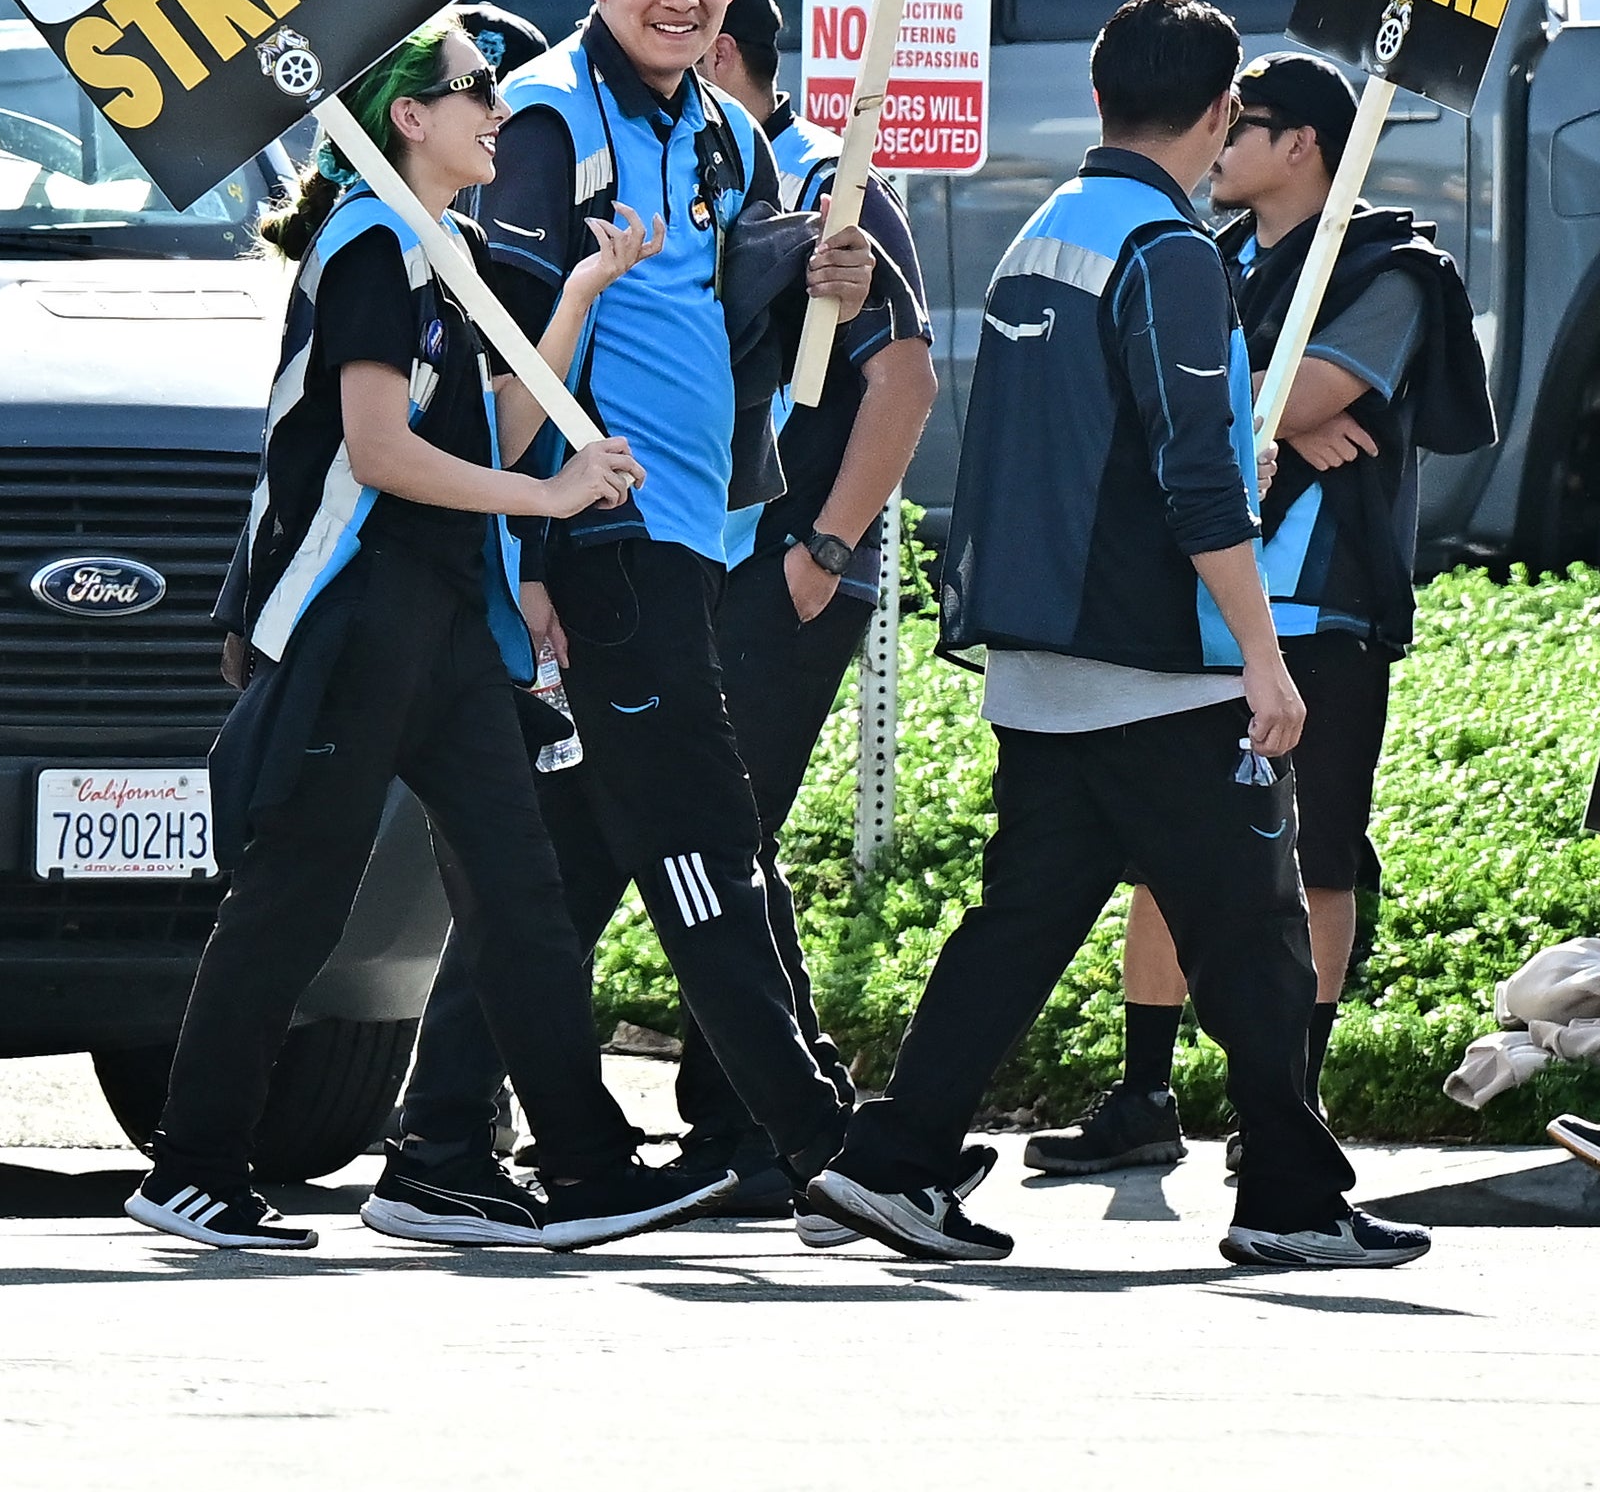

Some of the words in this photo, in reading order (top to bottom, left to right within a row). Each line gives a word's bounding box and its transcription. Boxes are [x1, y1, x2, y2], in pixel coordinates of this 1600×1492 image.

[812, 4, 867, 61] NO
[902, 1, 963, 21] ICITING
[897, 26, 956, 45] TERING
[891, 49, 979, 69] ESPASSING
[930, 95, 979, 123] WILL
[66, 565, 140, 603] Ford
[78, 777, 187, 809] California
[53, 812, 207, 860] 78902H3
[84, 863, 176, 873] dmv.ca.gov
